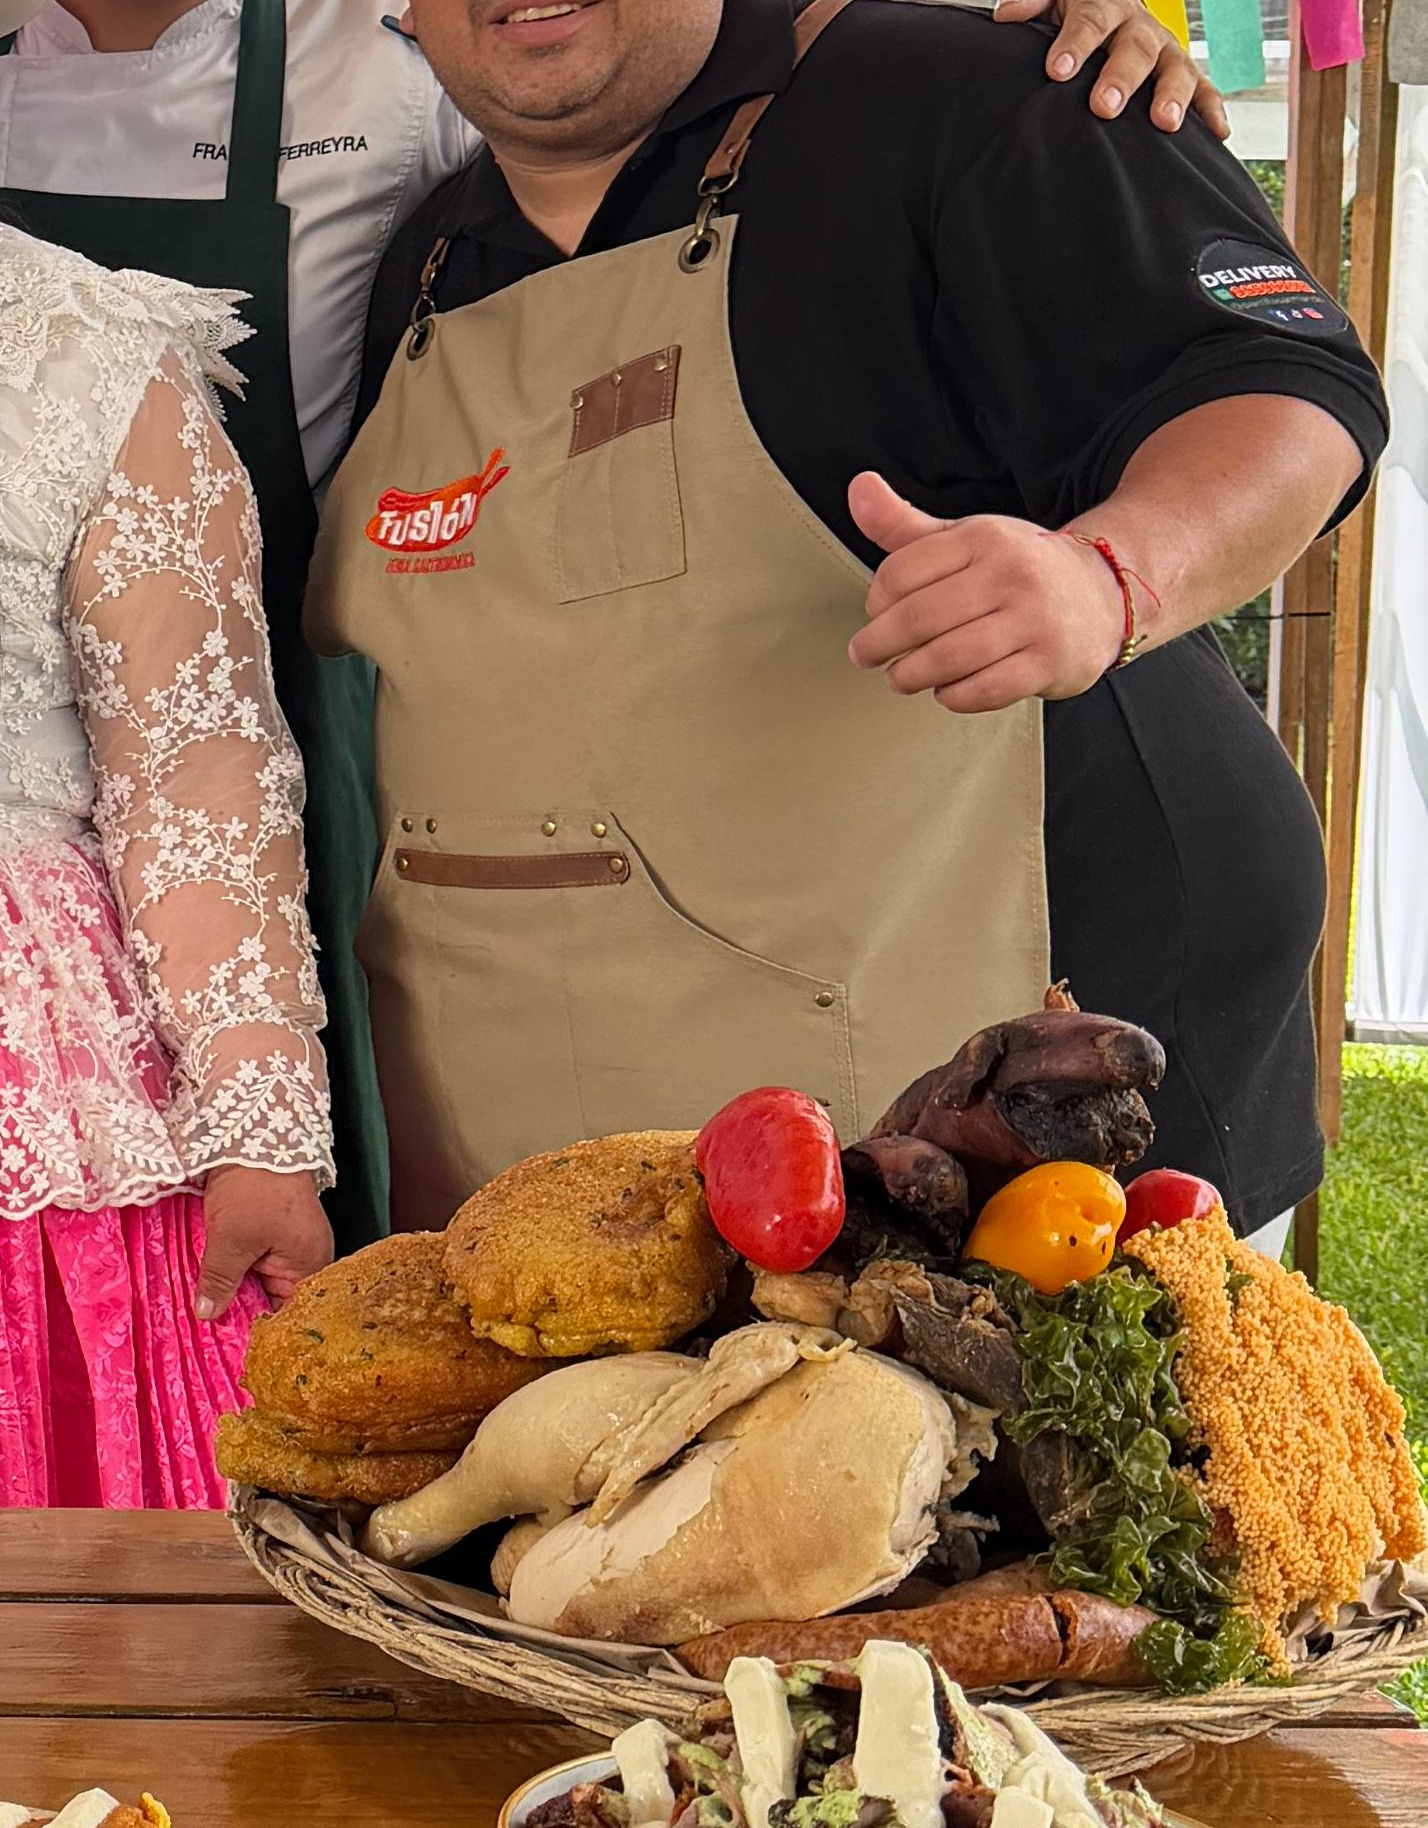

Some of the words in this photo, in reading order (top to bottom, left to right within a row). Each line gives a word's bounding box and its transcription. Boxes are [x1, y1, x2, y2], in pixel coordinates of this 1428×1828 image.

[192, 142, 228, 161] FRA
[278, 135, 369, 161] FERREYRA
[1198, 265, 1297, 288] DELIVERY
